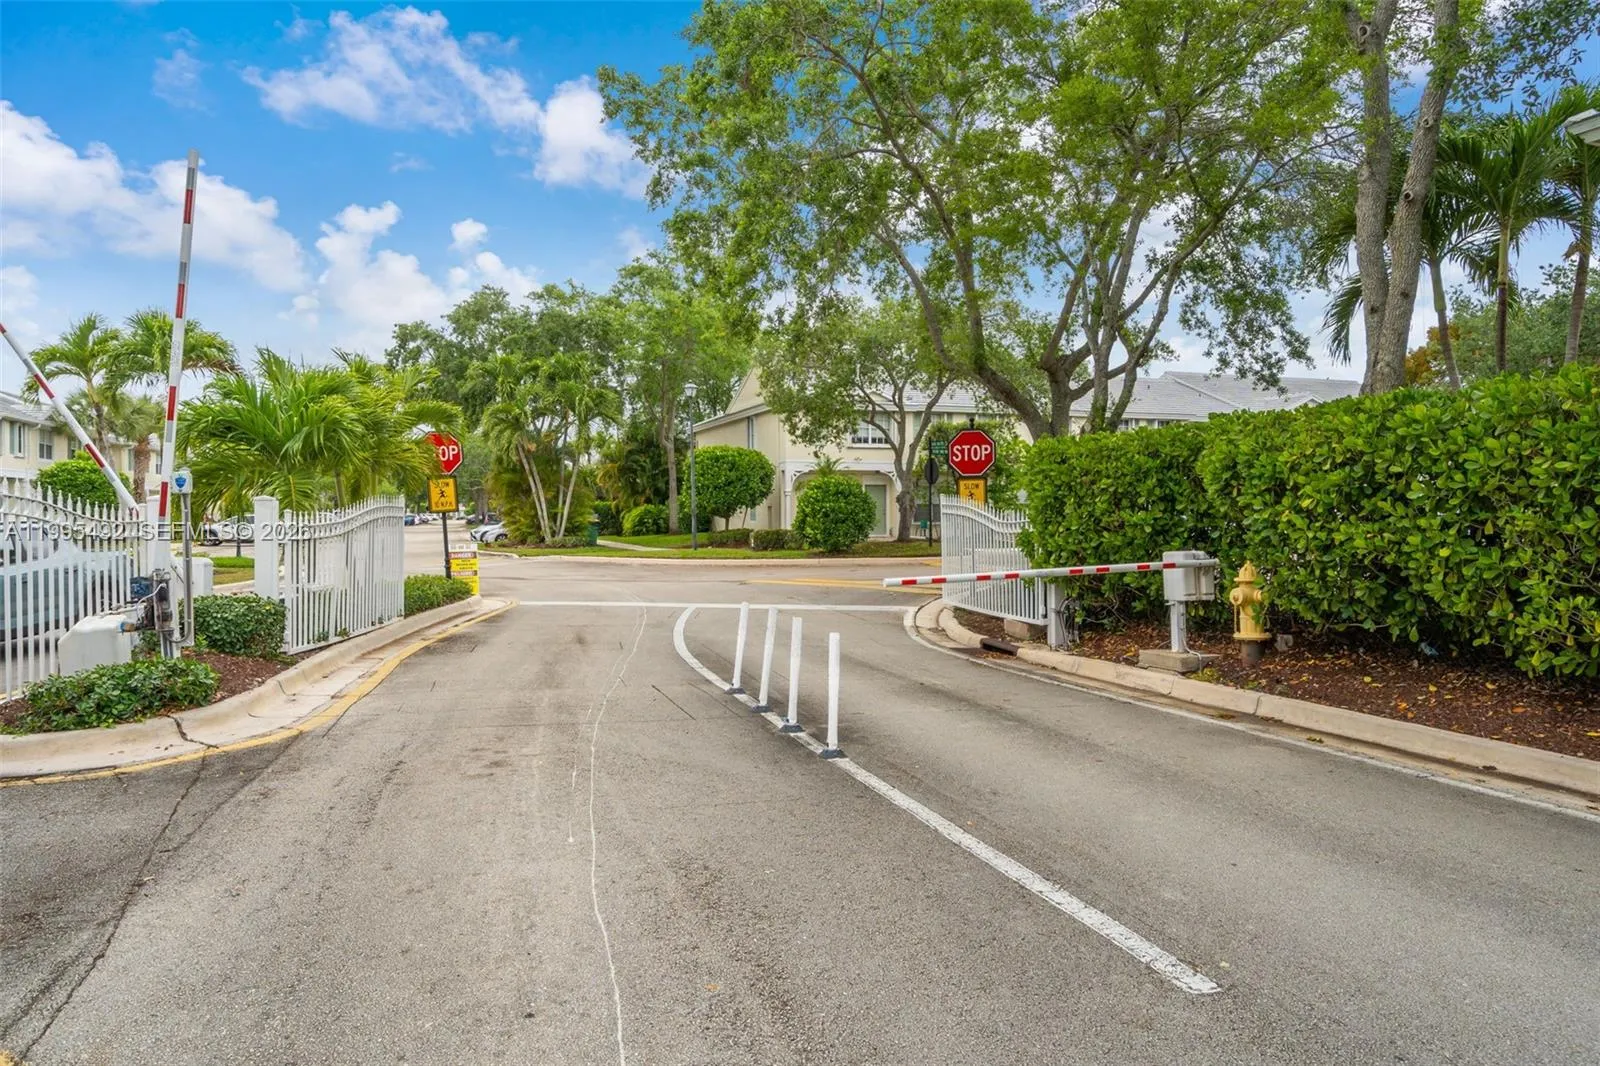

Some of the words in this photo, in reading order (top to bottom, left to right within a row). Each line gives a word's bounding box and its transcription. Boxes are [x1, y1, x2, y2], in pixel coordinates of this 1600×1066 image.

[439, 445, 458, 461] OP
[953, 444, 991, 462] STOP
[963, 482, 980, 490] SLOW
